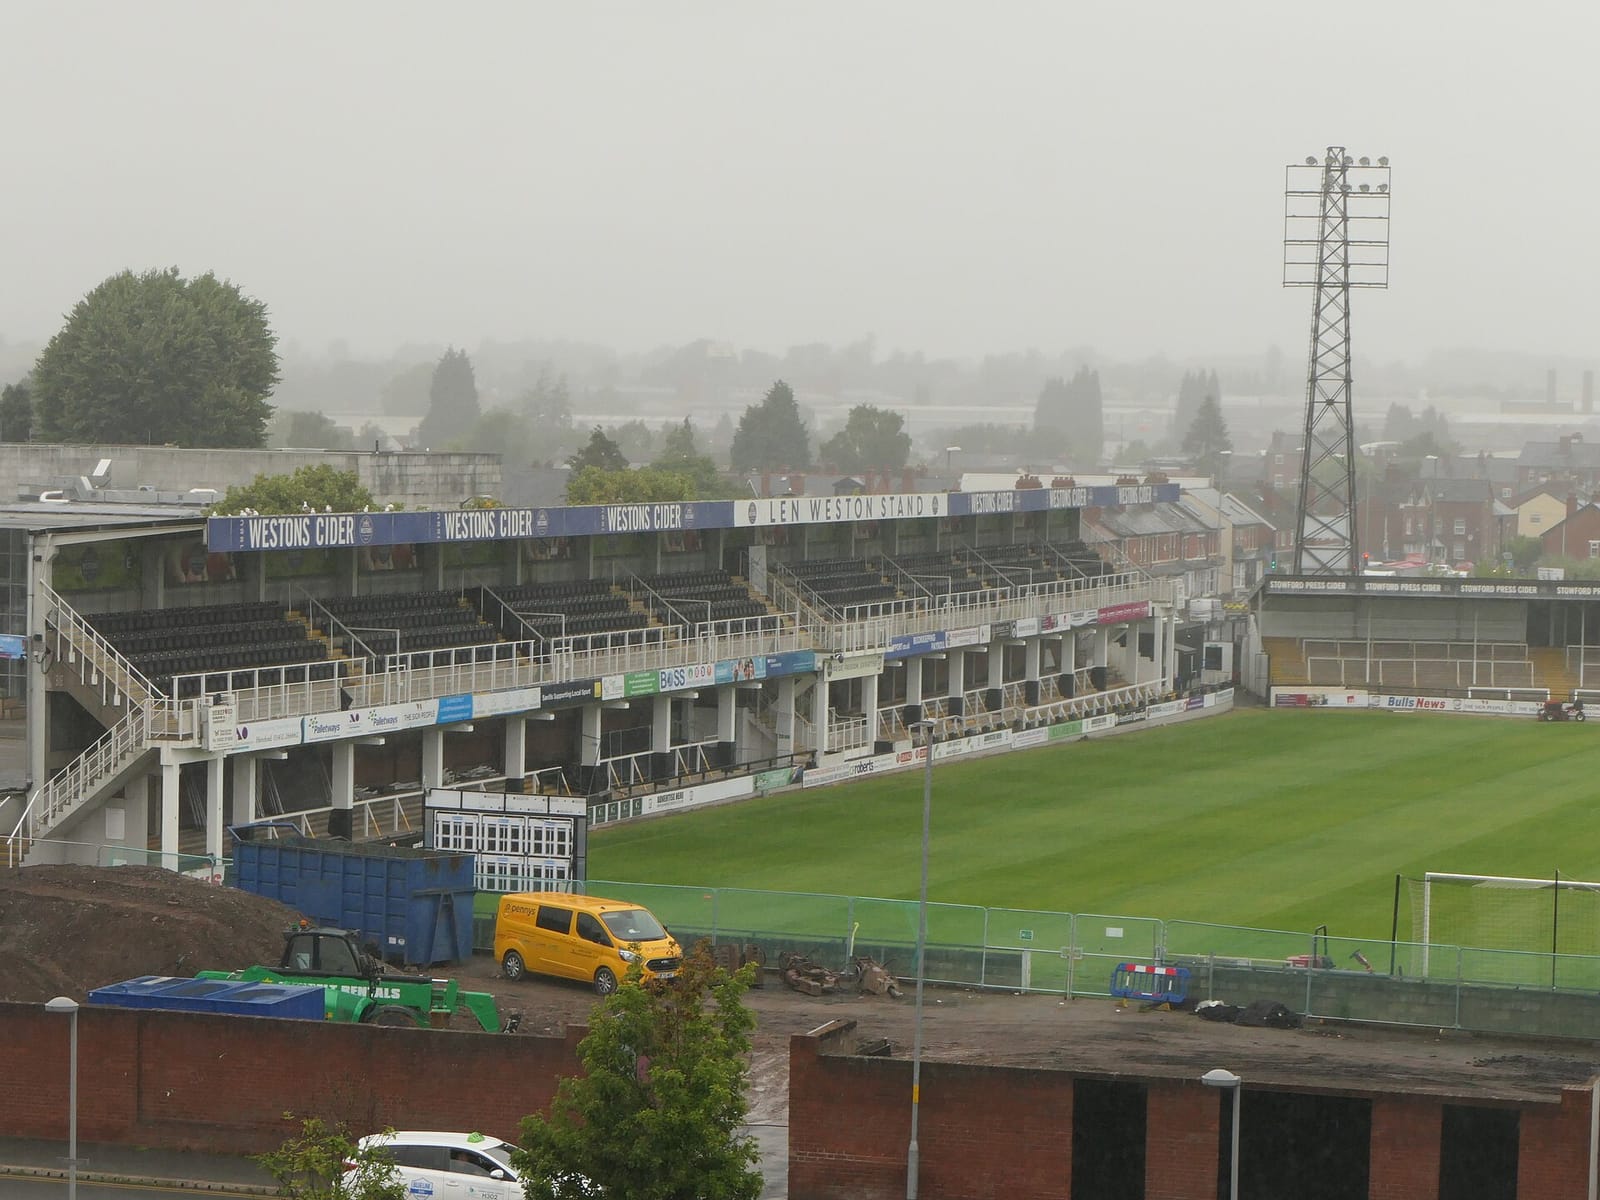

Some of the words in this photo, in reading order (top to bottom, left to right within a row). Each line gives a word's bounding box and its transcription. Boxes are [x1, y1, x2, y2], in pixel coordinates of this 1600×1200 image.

[770, 500, 799, 523] LEN
[810, 497, 873, 521] WESTON
[881, 496, 924, 517] STAND
[971, 493, 996, 513] WESTONS
[444, 510, 495, 540] WESTONS
[500, 510, 532, 537] CIDER
[607, 505, 650, 532] WESTONS
[654, 504, 681, 529] CIDER
[249, 517, 310, 549] WESTONS
[316, 516, 354, 546] CIDER
[1271, 581, 1304, 589] STOWFORD
[1305, 581, 1325, 589] PRESS
[1327, 582, 1346, 590] CIDER
[1365, 582, 1399, 591] STOWFORD
[1400, 583, 1421, 591] PRESS
[1422, 584, 1441, 592] CIDER
[1460, 585, 1495, 593] STOWFORD
[1496, 585, 1517, 593] PRESS
[1518, 586, 1537, 594] CIDER
[1556, 587, 1591, 595] STOWFORD
[1388, 697, 1414, 707] Bulls
[1416, 698, 1446, 709] News
[314, 723, 341, 734] Palletways
[854, 760, 874, 774] roberts
[341, 985, 401, 999] RENALS
